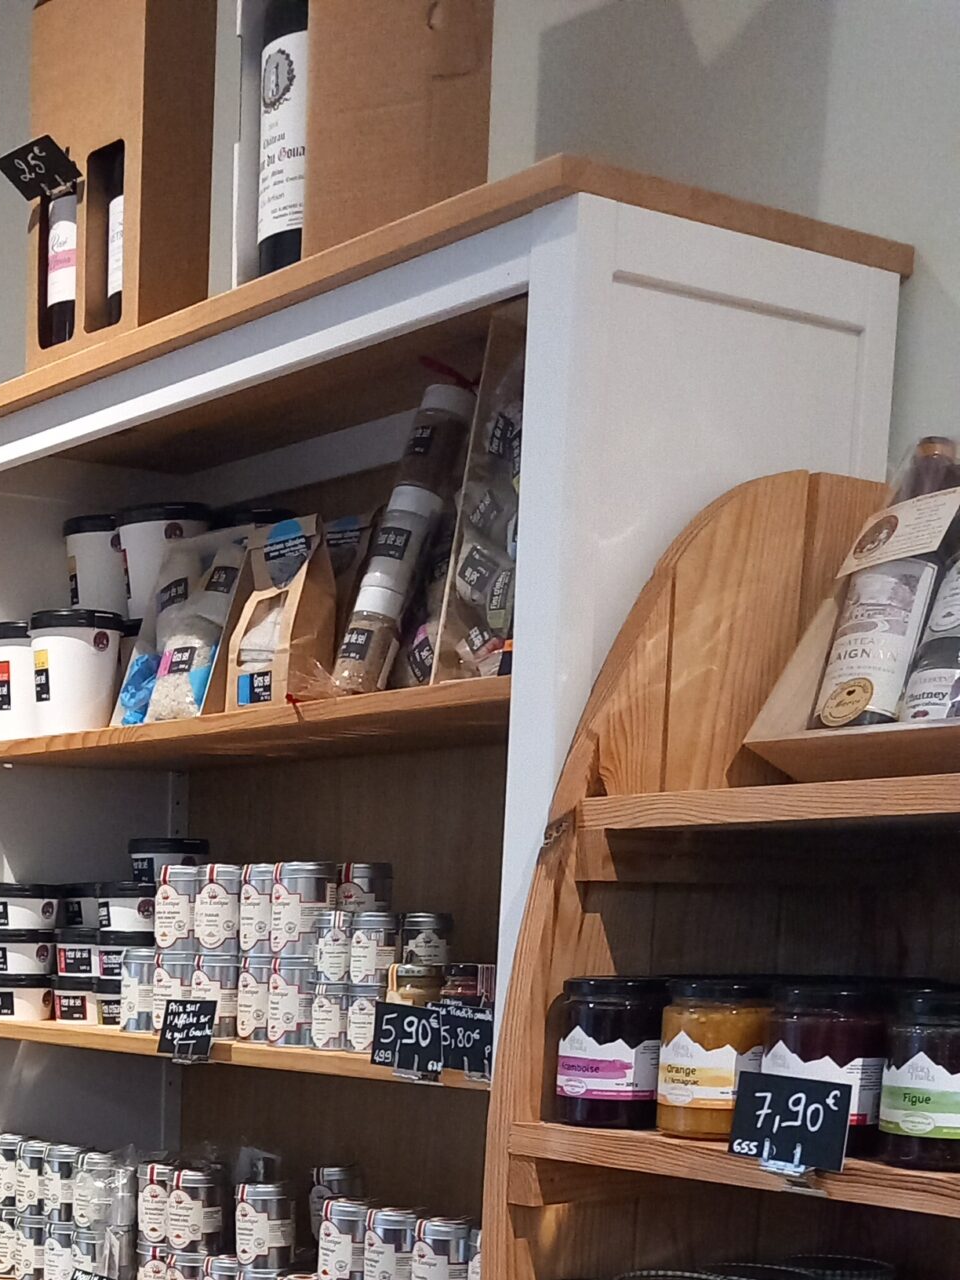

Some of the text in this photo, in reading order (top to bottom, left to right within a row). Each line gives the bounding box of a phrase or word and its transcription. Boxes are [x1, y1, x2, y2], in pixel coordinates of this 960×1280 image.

[186, 1002, 200, 1013] sur
[380, 1013, 440, 1047] 5,90€
[666, 1063, 697, 1077] Orange
[902, 1092, 932, 1107] Figue
[754, 1088, 842, 1133] 7,90€
